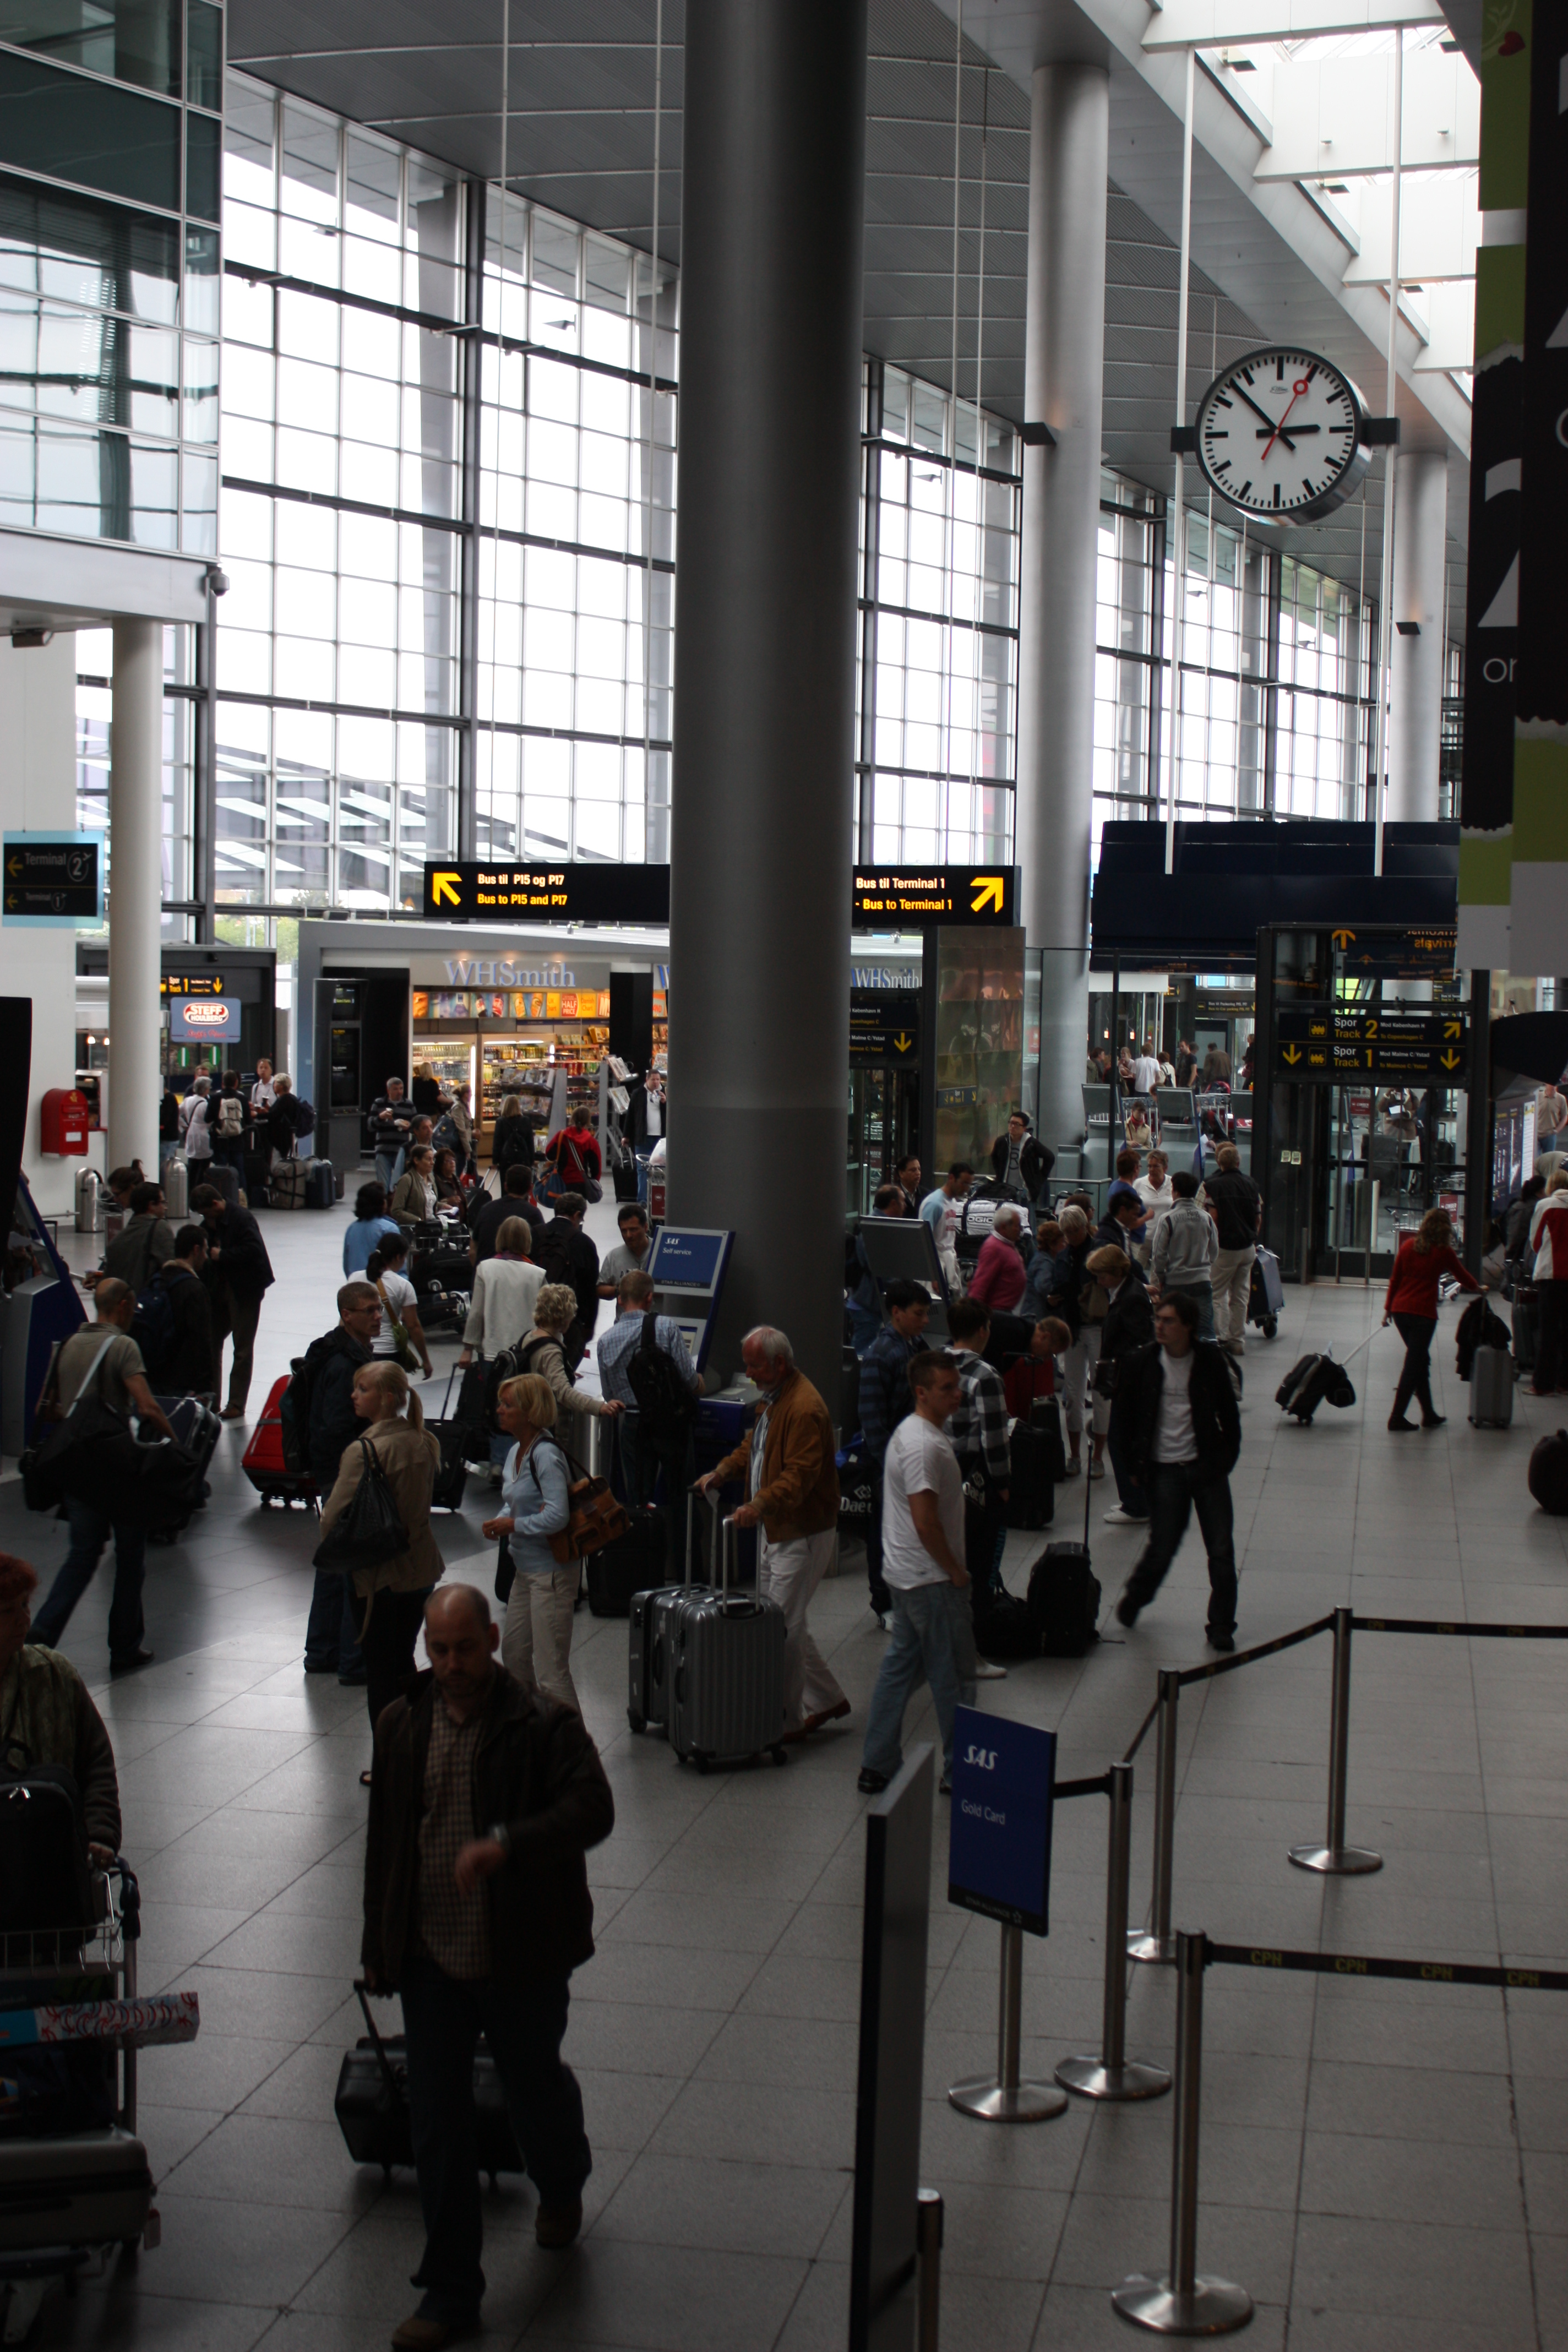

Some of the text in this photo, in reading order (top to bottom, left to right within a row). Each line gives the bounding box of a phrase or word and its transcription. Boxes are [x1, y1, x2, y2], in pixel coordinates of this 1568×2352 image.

[24, 852, 81, 875] Terminal 2
[477, 874, 564, 887] Bus til P15 og P17
[856, 878, 945, 889] Bus til Terminal 1
[25, 892, 60, 908] Terminal 1
[477, 894, 567, 905] Bus to P15 and P17
[863, 899, 883, 910] Bus
[886, 900, 896, 910] to
[900, 899, 944, 910] Terminal
[948, 899, 952, 910] 1
[443, 961, 576, 987] WHSmith
[853, 967, 919, 989] WHSmith
[190, 1005, 223, 1015] STEFF
[1335, 1017, 1357, 1028] Spor
[1365, 1019, 1378, 1039] 2
[1335, 1030, 1361, 1039] Track
[1333, 1046, 1356, 1057] Spor
[1365, 1048, 1373, 1068] 1
[1333, 1058, 1359, 1068] Track
[665, 1237, 680, 1245] SAS
[963, 1745, 998, 1771] SAS
[961, 1798, 1006, 1826] Gold Card
[1250, 1950, 1283, 1967] CPH
[1335, 1957, 1368, 1974] CPH
[1420, 1964, 1453, 1981] CPH
[1506, 1972, 1540, 1987] CPH
